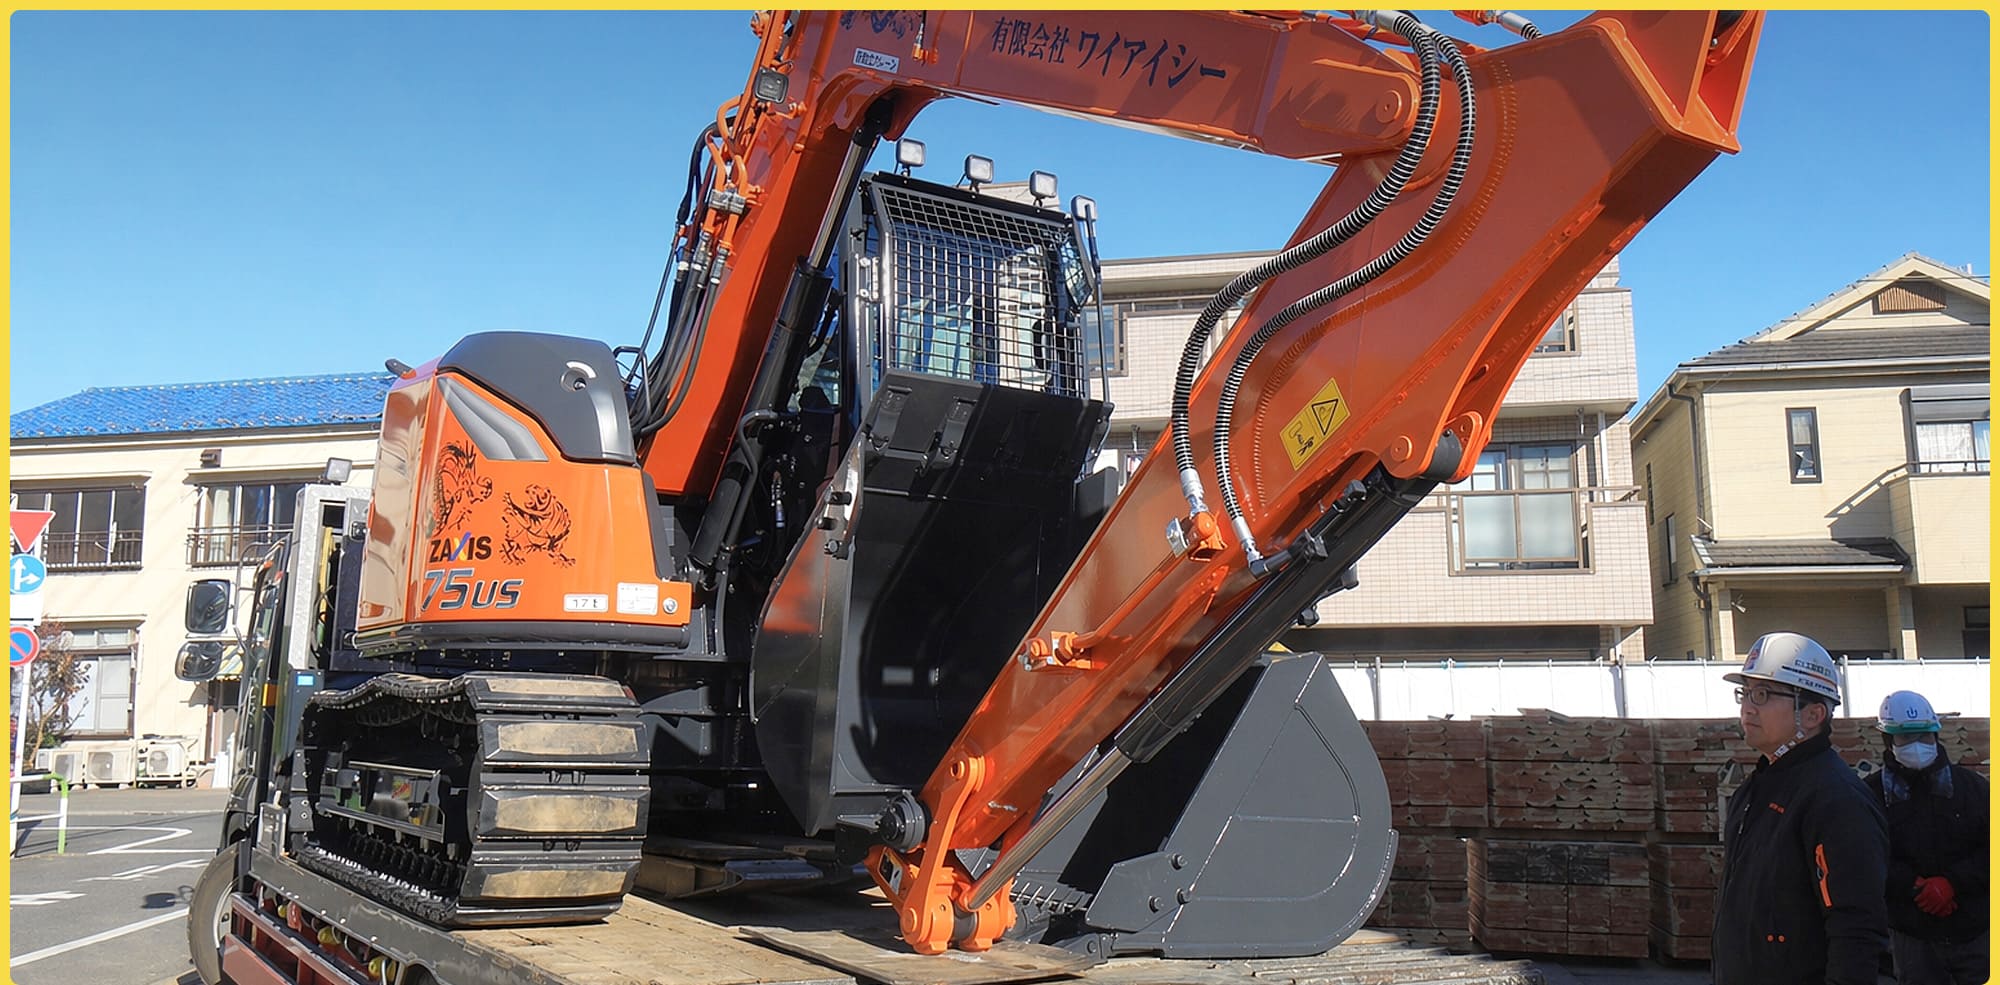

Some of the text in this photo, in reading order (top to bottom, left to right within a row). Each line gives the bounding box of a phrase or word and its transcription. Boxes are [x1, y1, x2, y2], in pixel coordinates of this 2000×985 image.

[992, 16, 1226, 88] 有限会社 ワイアイシー
[430, 532, 492, 562] ZAXIS
